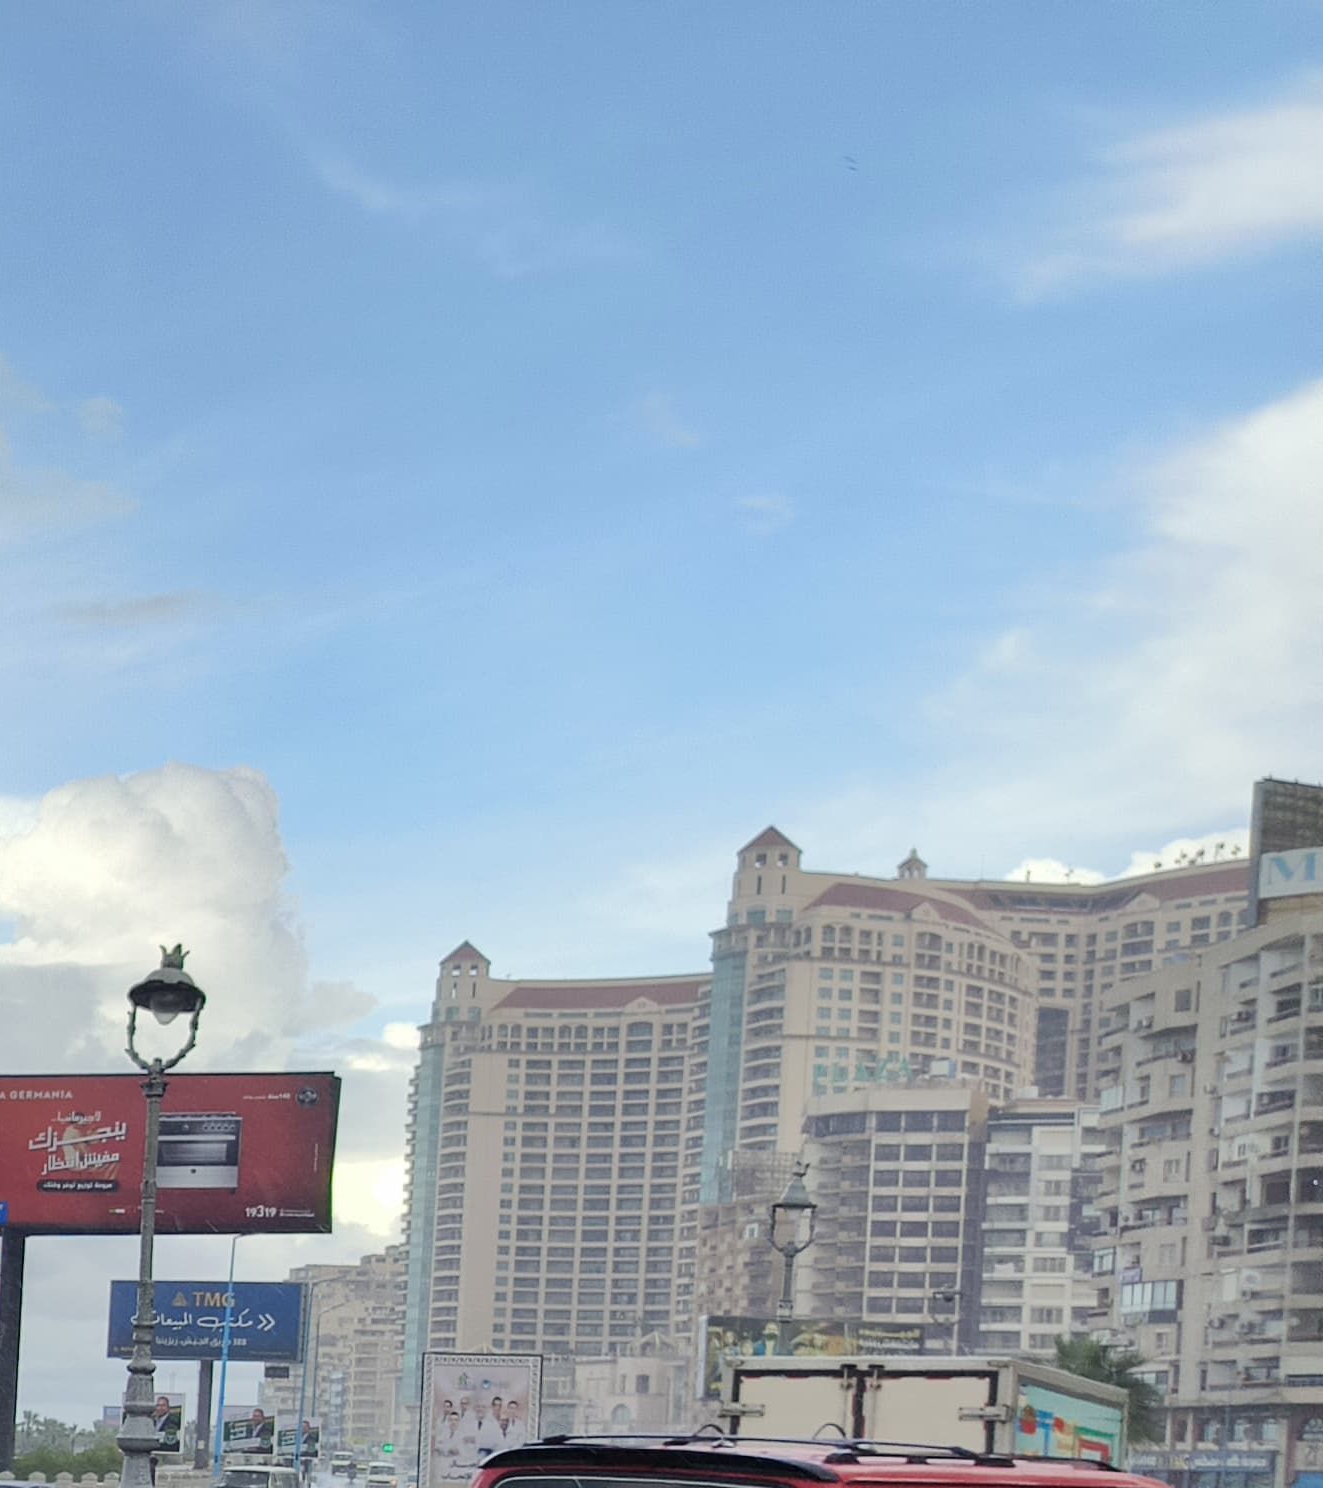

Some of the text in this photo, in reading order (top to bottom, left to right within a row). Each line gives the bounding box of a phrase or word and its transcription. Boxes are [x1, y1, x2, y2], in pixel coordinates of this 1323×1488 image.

[9, 1090, 73, 1100] GERMANIA
[245, 1204, 277, 1218] 19319
[192, 1292, 236, 1307] TMG
[197, 1308, 253, 1333] مكتب
